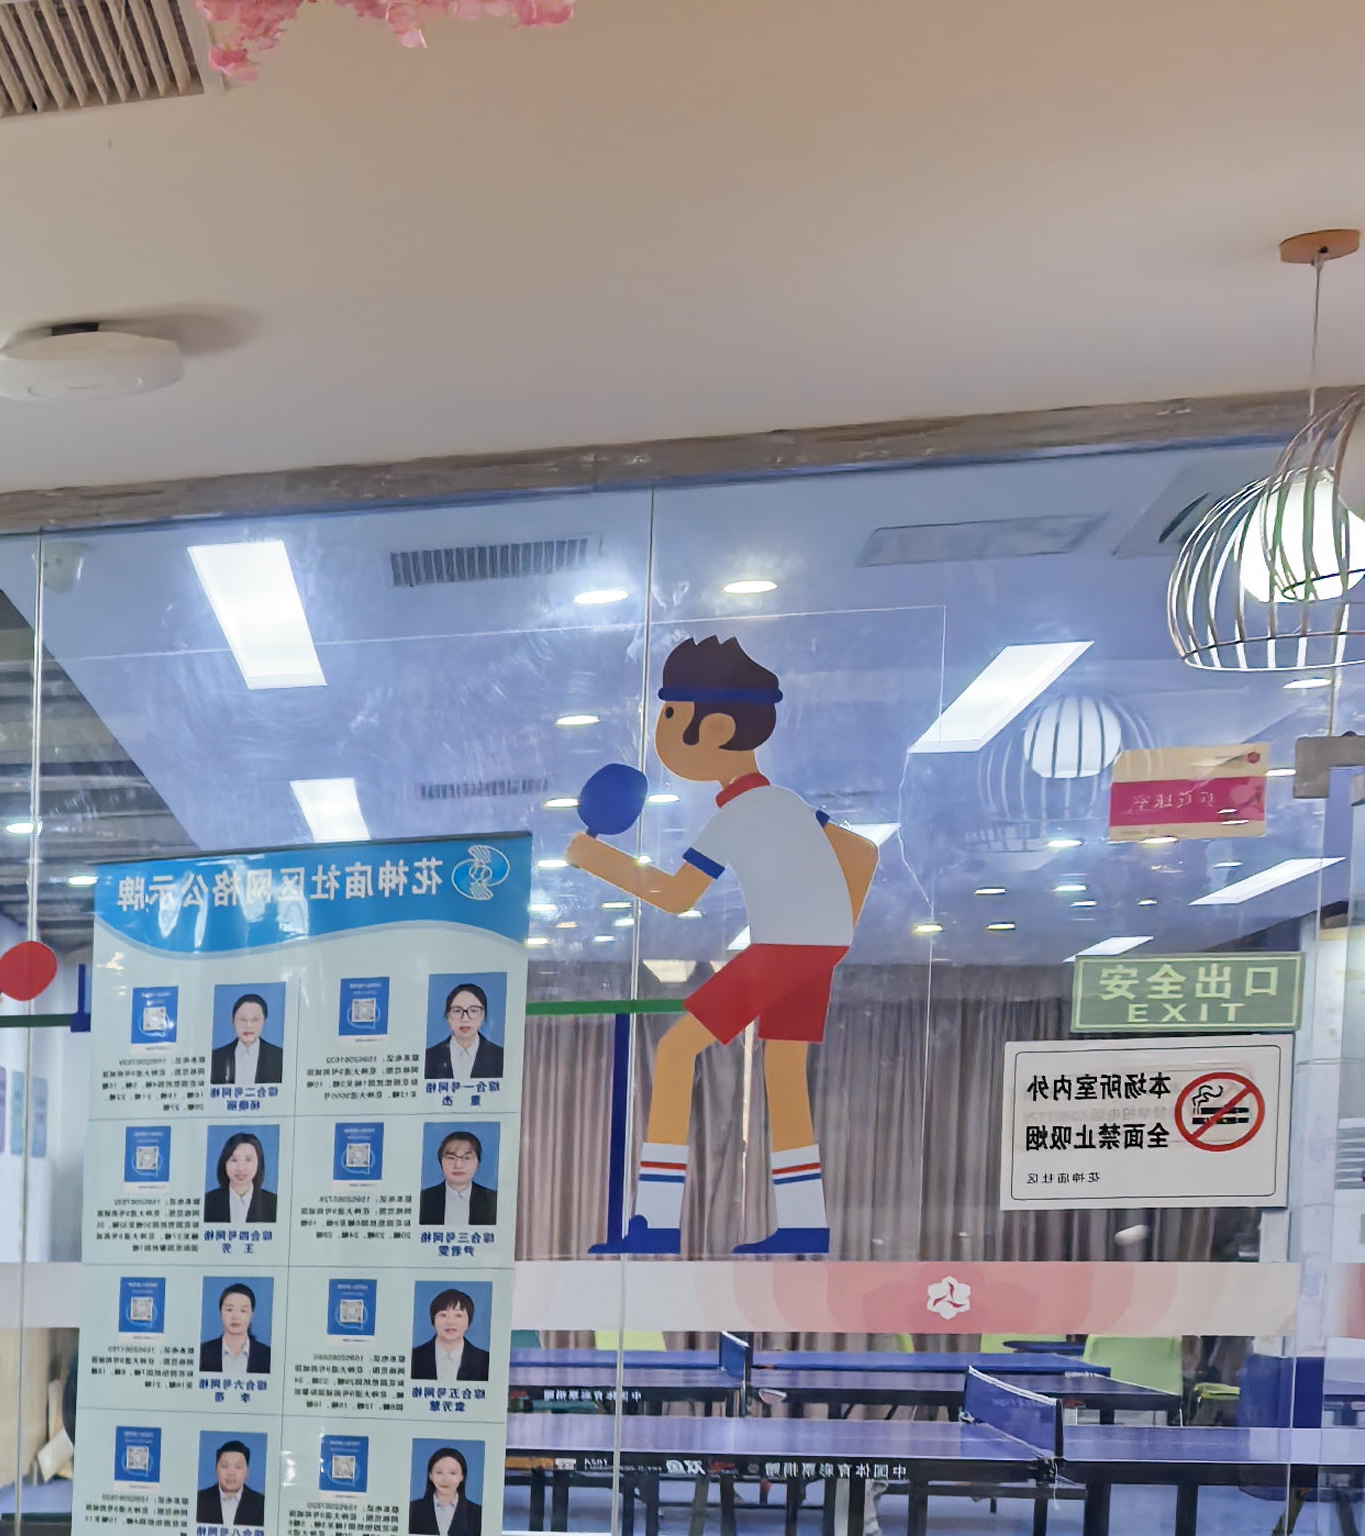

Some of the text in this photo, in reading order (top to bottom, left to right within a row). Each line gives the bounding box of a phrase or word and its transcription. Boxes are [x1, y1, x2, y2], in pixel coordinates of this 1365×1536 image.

[1099, 963, 1278, 1000] 安全出口
[1127, 1003, 1245, 1022] EXIT
